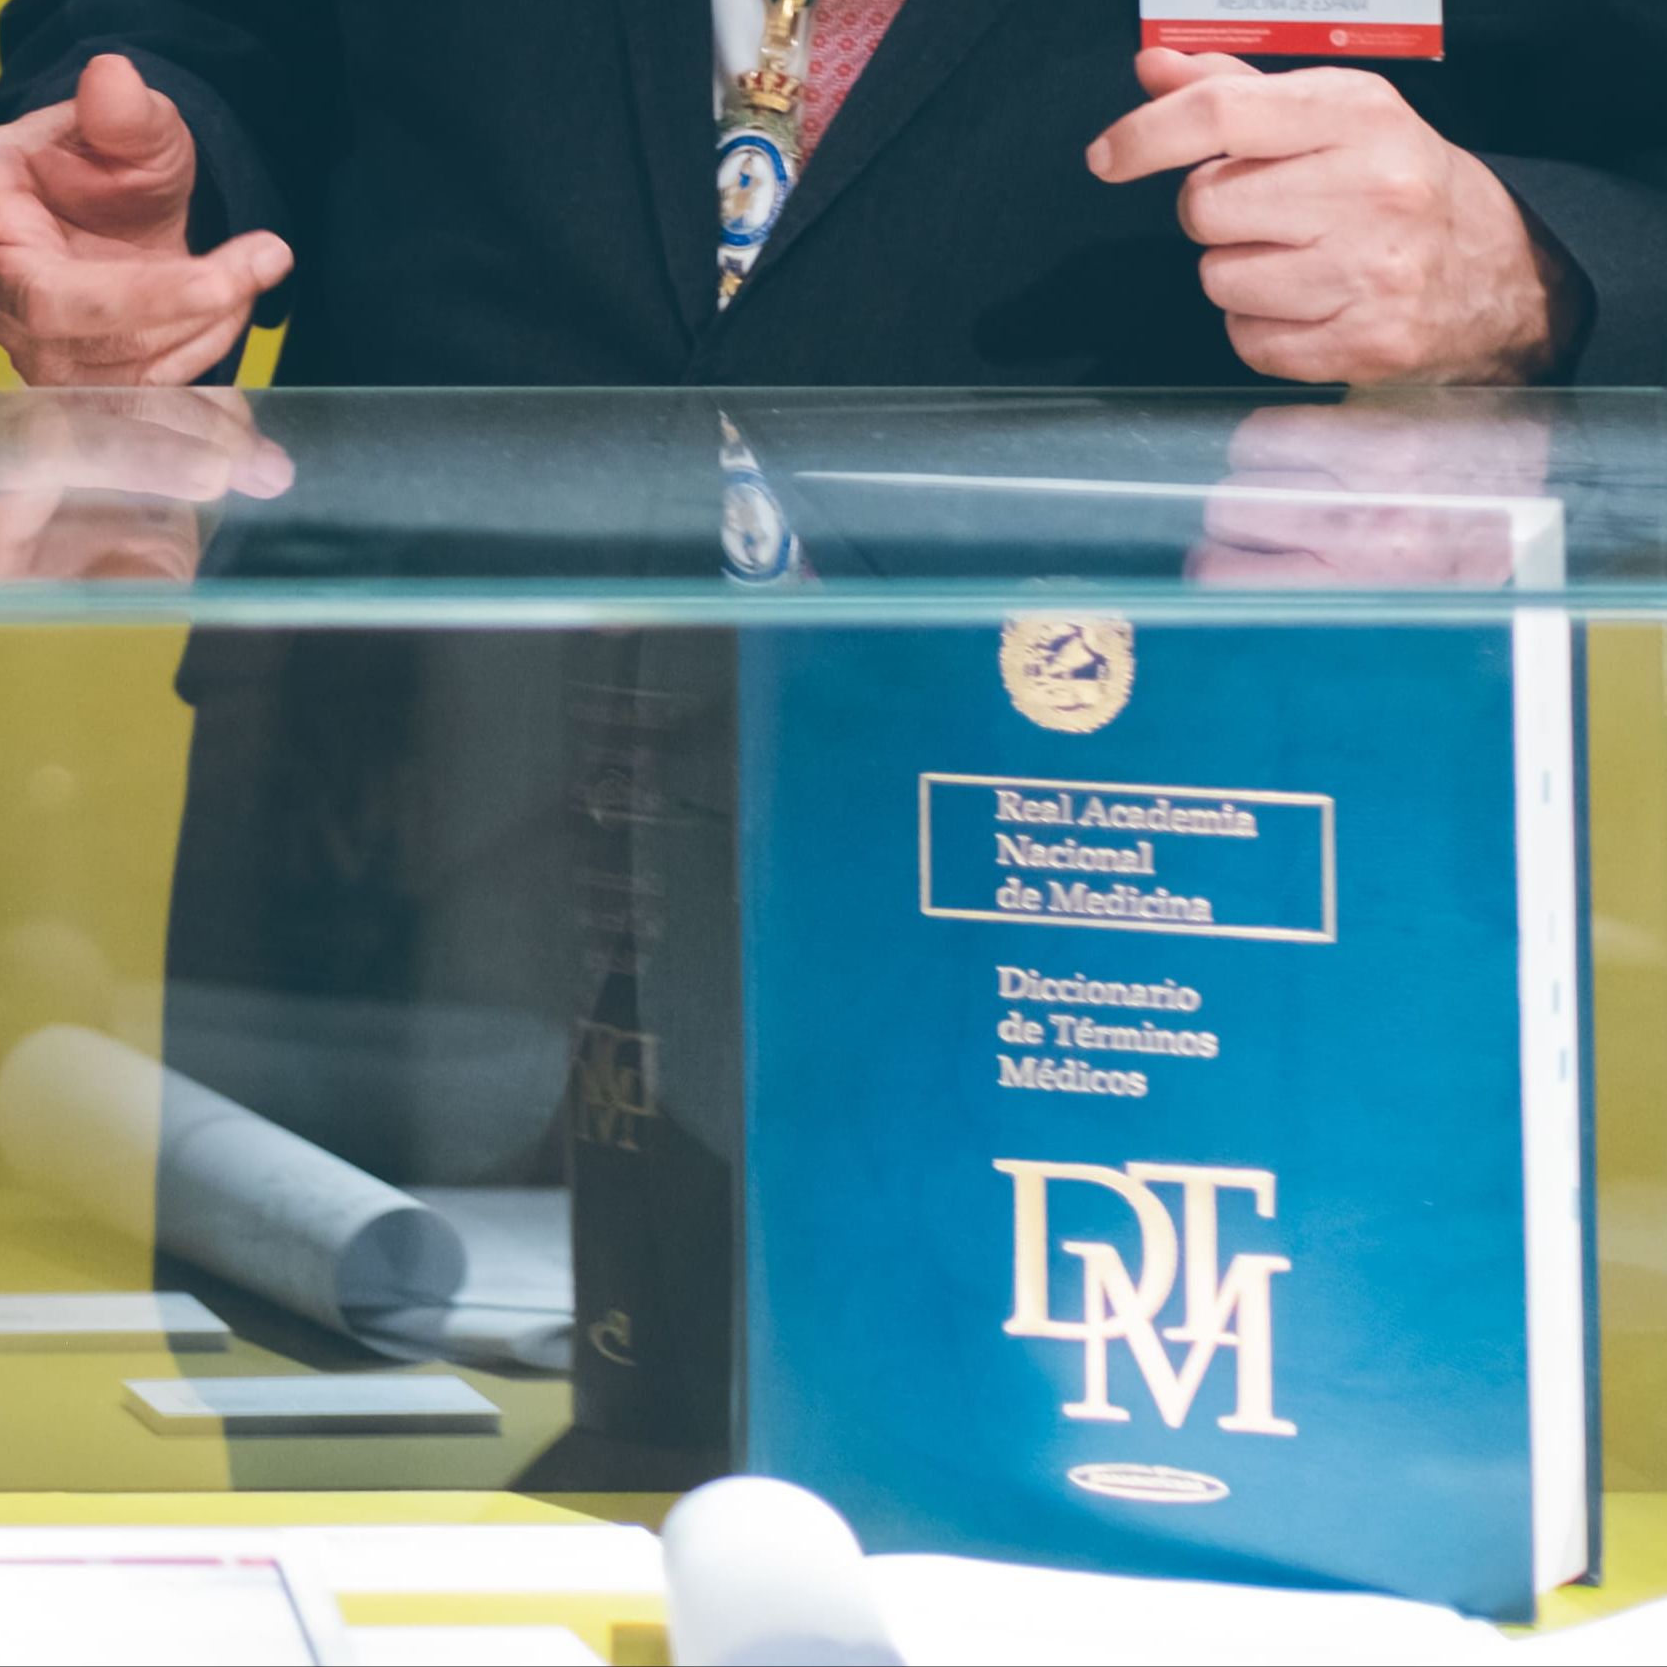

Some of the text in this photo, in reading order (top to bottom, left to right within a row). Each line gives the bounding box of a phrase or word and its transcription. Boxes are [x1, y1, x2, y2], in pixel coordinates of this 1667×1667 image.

[994, 789, 1259, 839] Real Academia
[995, 832, 1156, 875] Nacional
[995, 876, 1214, 924] de Medicina
[995, 964, 1202, 1013] Diccionario
[996, 1010, 1220, 1059] de Términos
[996, 1054, 1149, 1098] Médicos
